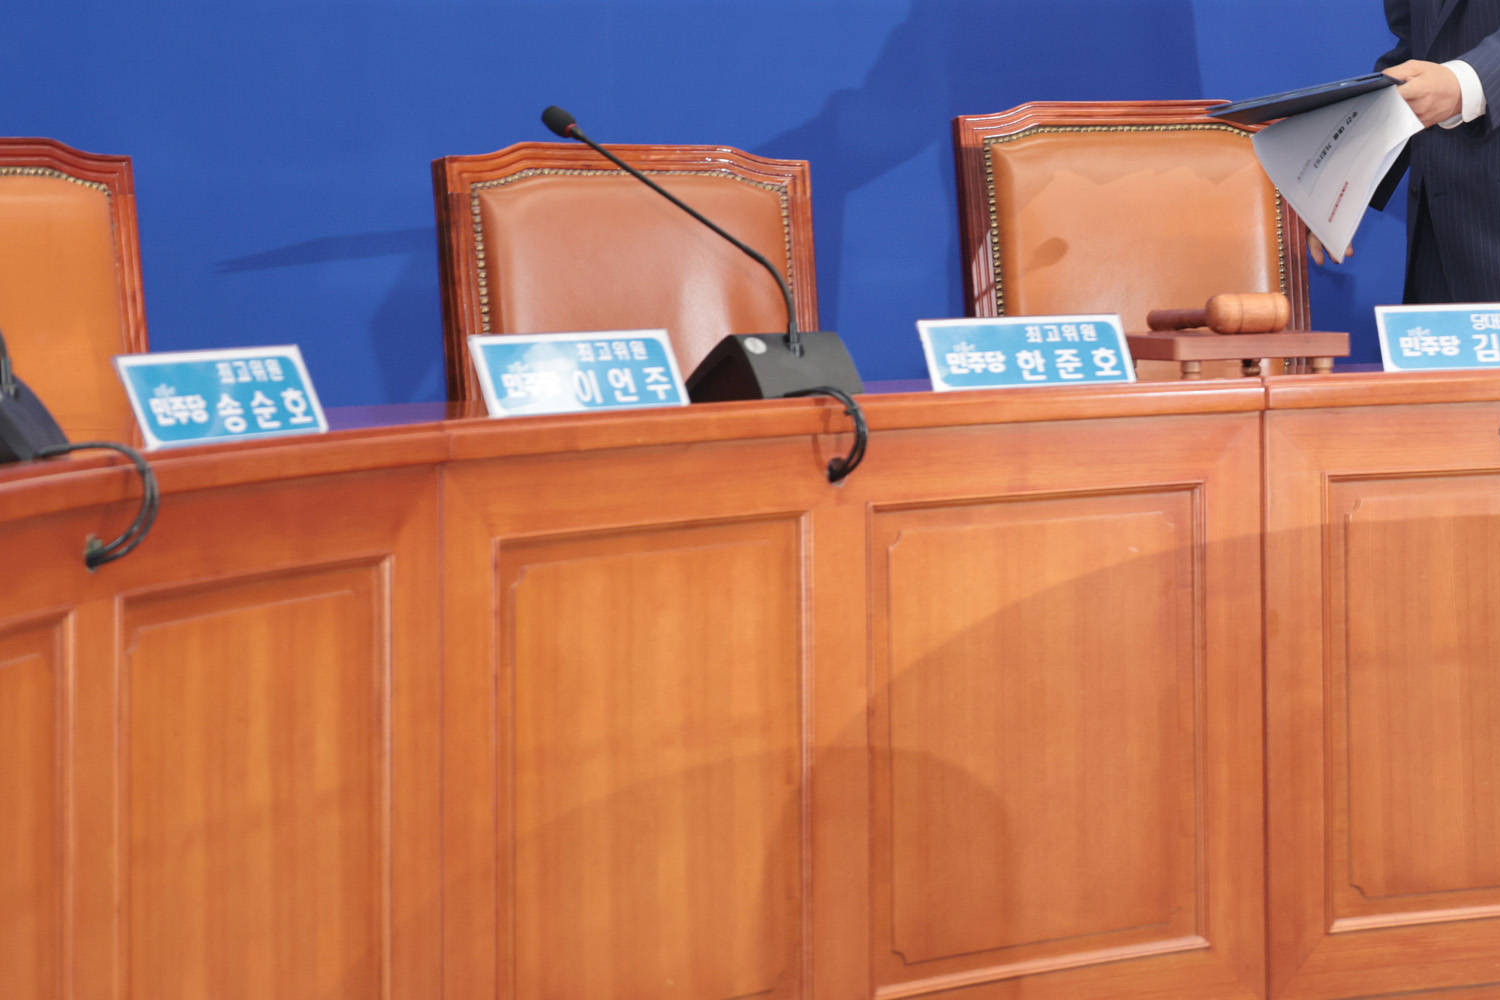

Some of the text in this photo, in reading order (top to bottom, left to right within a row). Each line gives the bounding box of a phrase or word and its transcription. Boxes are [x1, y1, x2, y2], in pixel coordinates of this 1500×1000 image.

[1024, 323, 1099, 343] 최고위원
[575, 340, 649, 362] 최고위원
[1399, 335, 1462, 357] 민주당
[945, 350, 1007, 375] 민주당
[1015, 347, 1122, 381] 한준호
[573, 366, 672, 404] 이언주
[216, 387, 314, 434] 송순호
